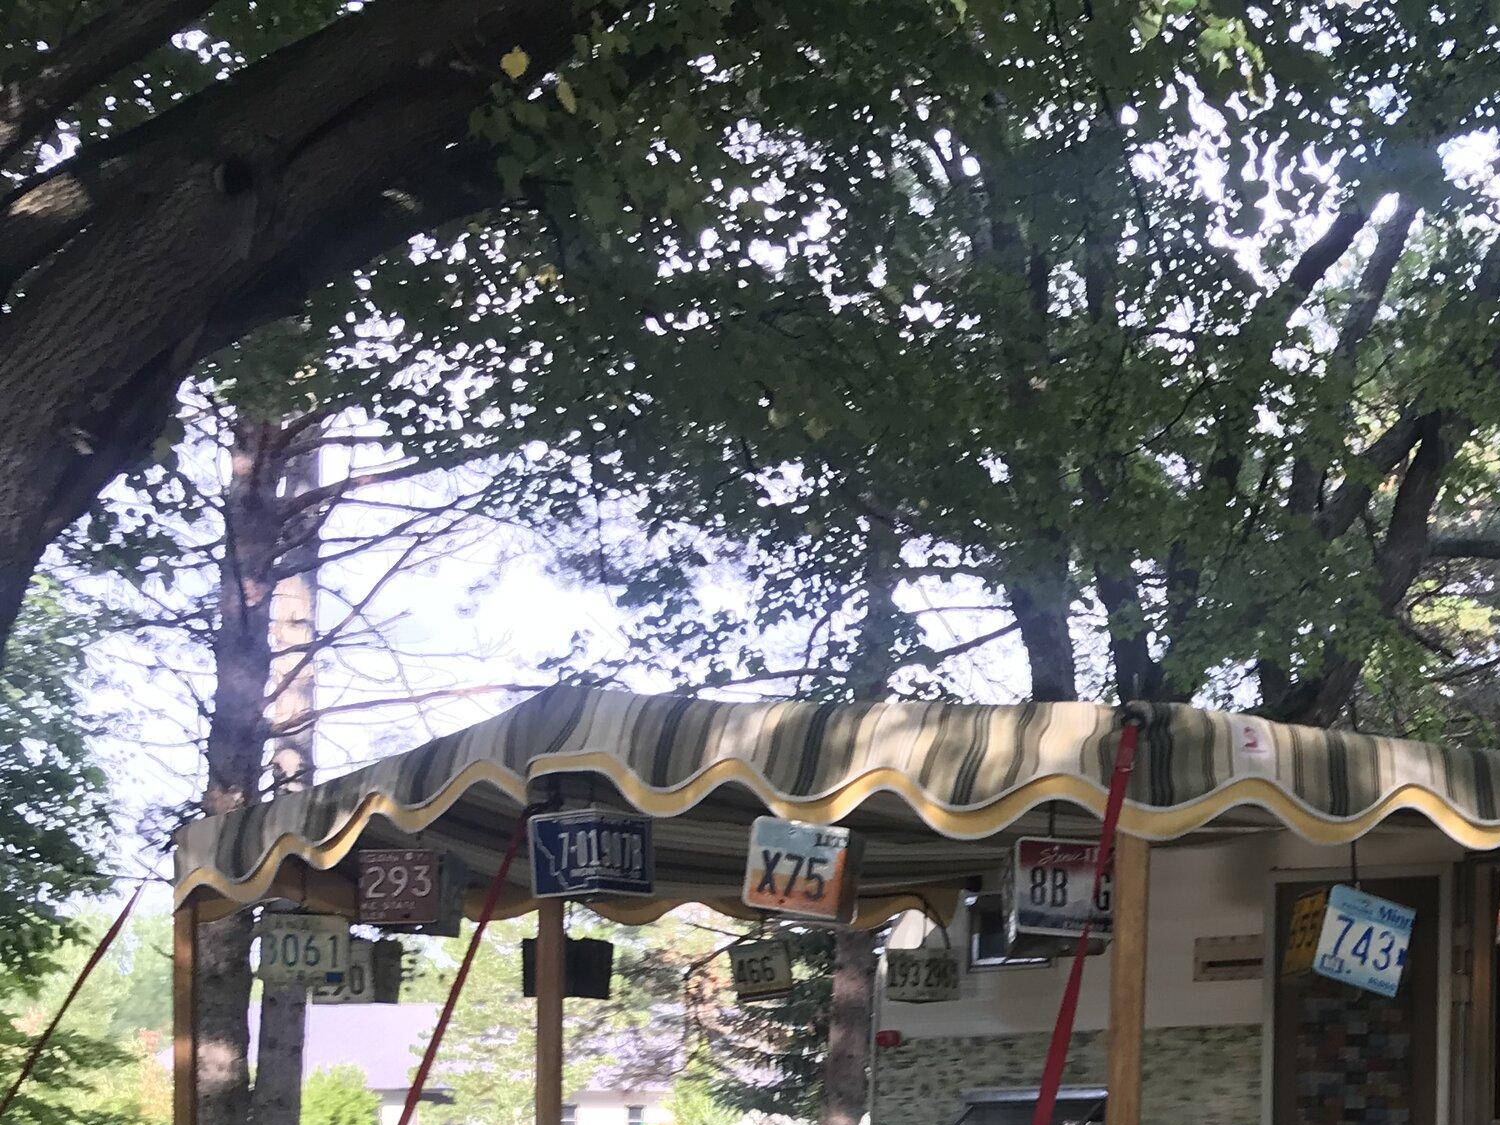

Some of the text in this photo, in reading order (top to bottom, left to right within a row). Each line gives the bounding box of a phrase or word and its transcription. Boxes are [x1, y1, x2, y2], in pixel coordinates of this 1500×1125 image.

[365, 865, 433, 899] 293
[756, 849, 829, 902] X75
[1331, 914, 1396, 972] 743
